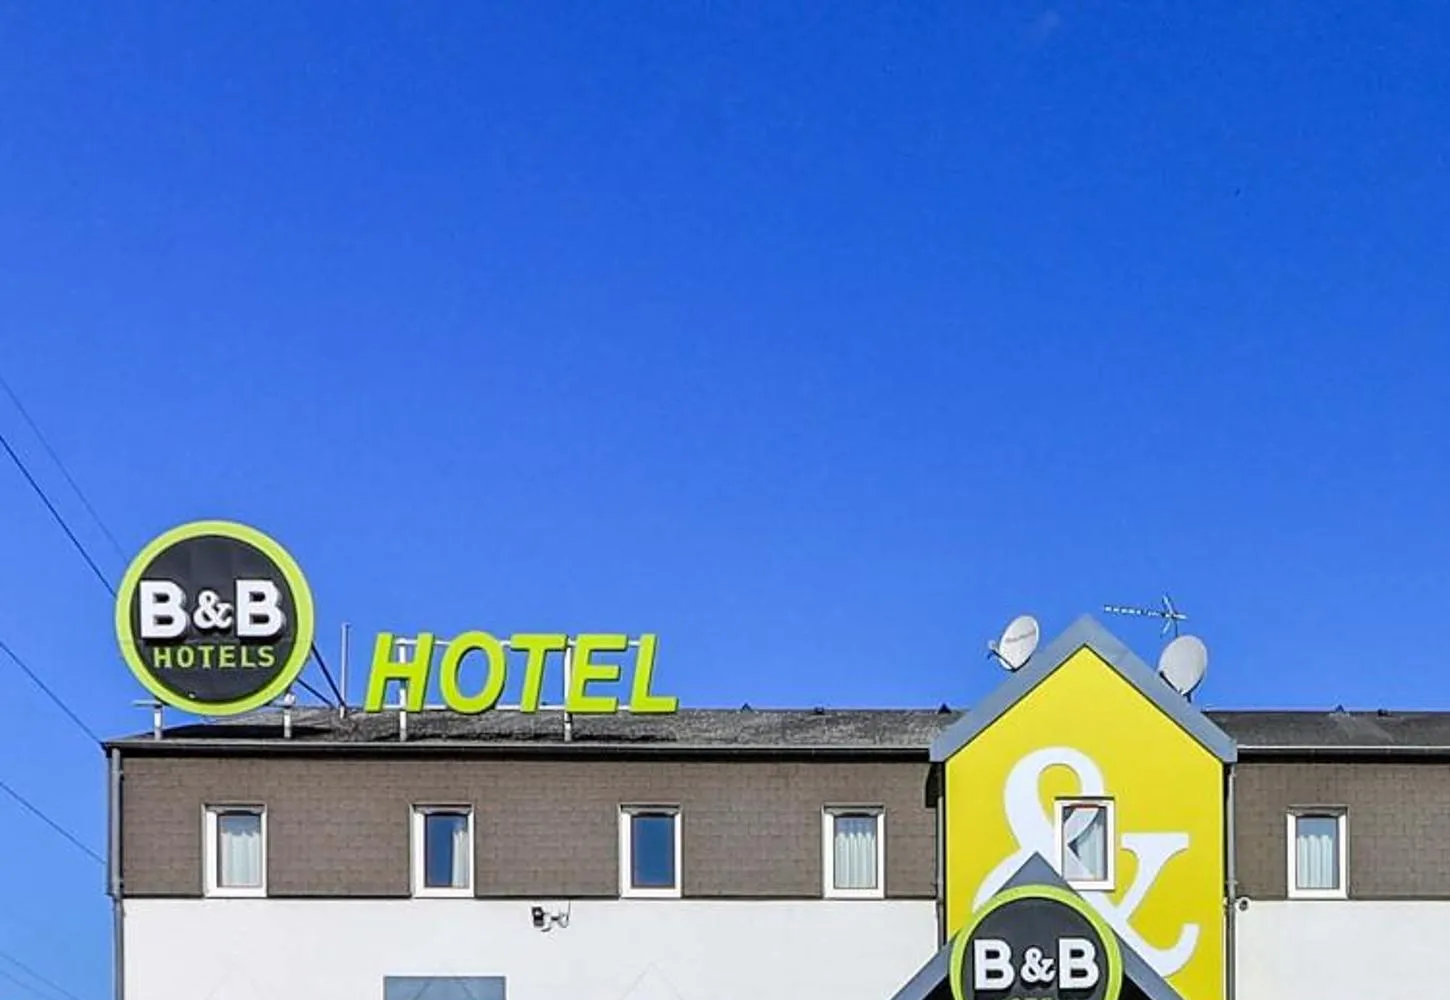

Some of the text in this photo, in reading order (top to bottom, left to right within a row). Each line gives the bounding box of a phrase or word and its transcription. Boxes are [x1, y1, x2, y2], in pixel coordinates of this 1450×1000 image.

[140, 580, 285, 638] B&B
[153, 645, 276, 669] HOTELS
[364, 630, 679, 715] HOTEL
[974, 938, 1100, 990] B&B
